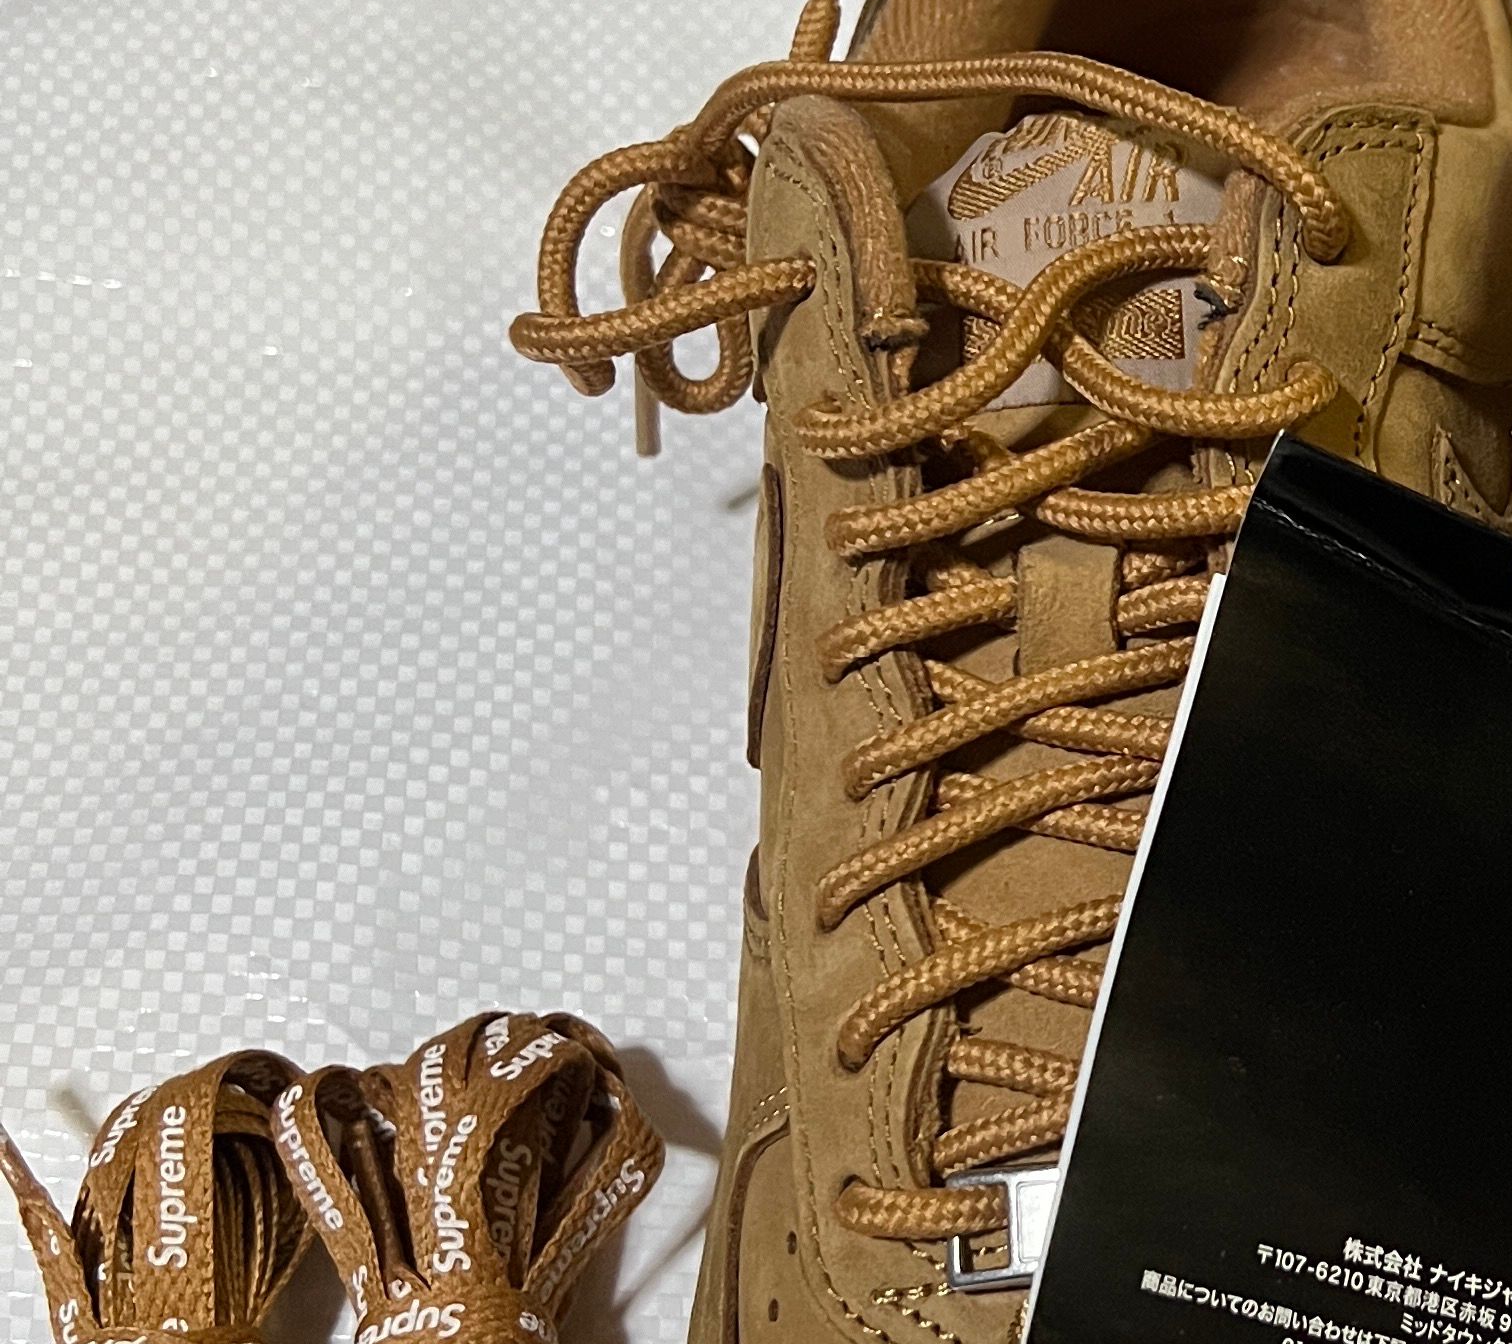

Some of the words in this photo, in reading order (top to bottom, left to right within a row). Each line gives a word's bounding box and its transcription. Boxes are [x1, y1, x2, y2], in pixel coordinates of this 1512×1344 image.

[954, 225, 1001, 265] AIR
[1068, 140, 1180, 207] AIR
[147, 1104, 199, 1269] Supreme
[277, 1084, 345, 1231] Supreme
[433, 1113, 479, 1273] Supreme
[539, 1157, 646, 1304] Supreme
[1343, 1235, 1423, 1281] 株式会社
